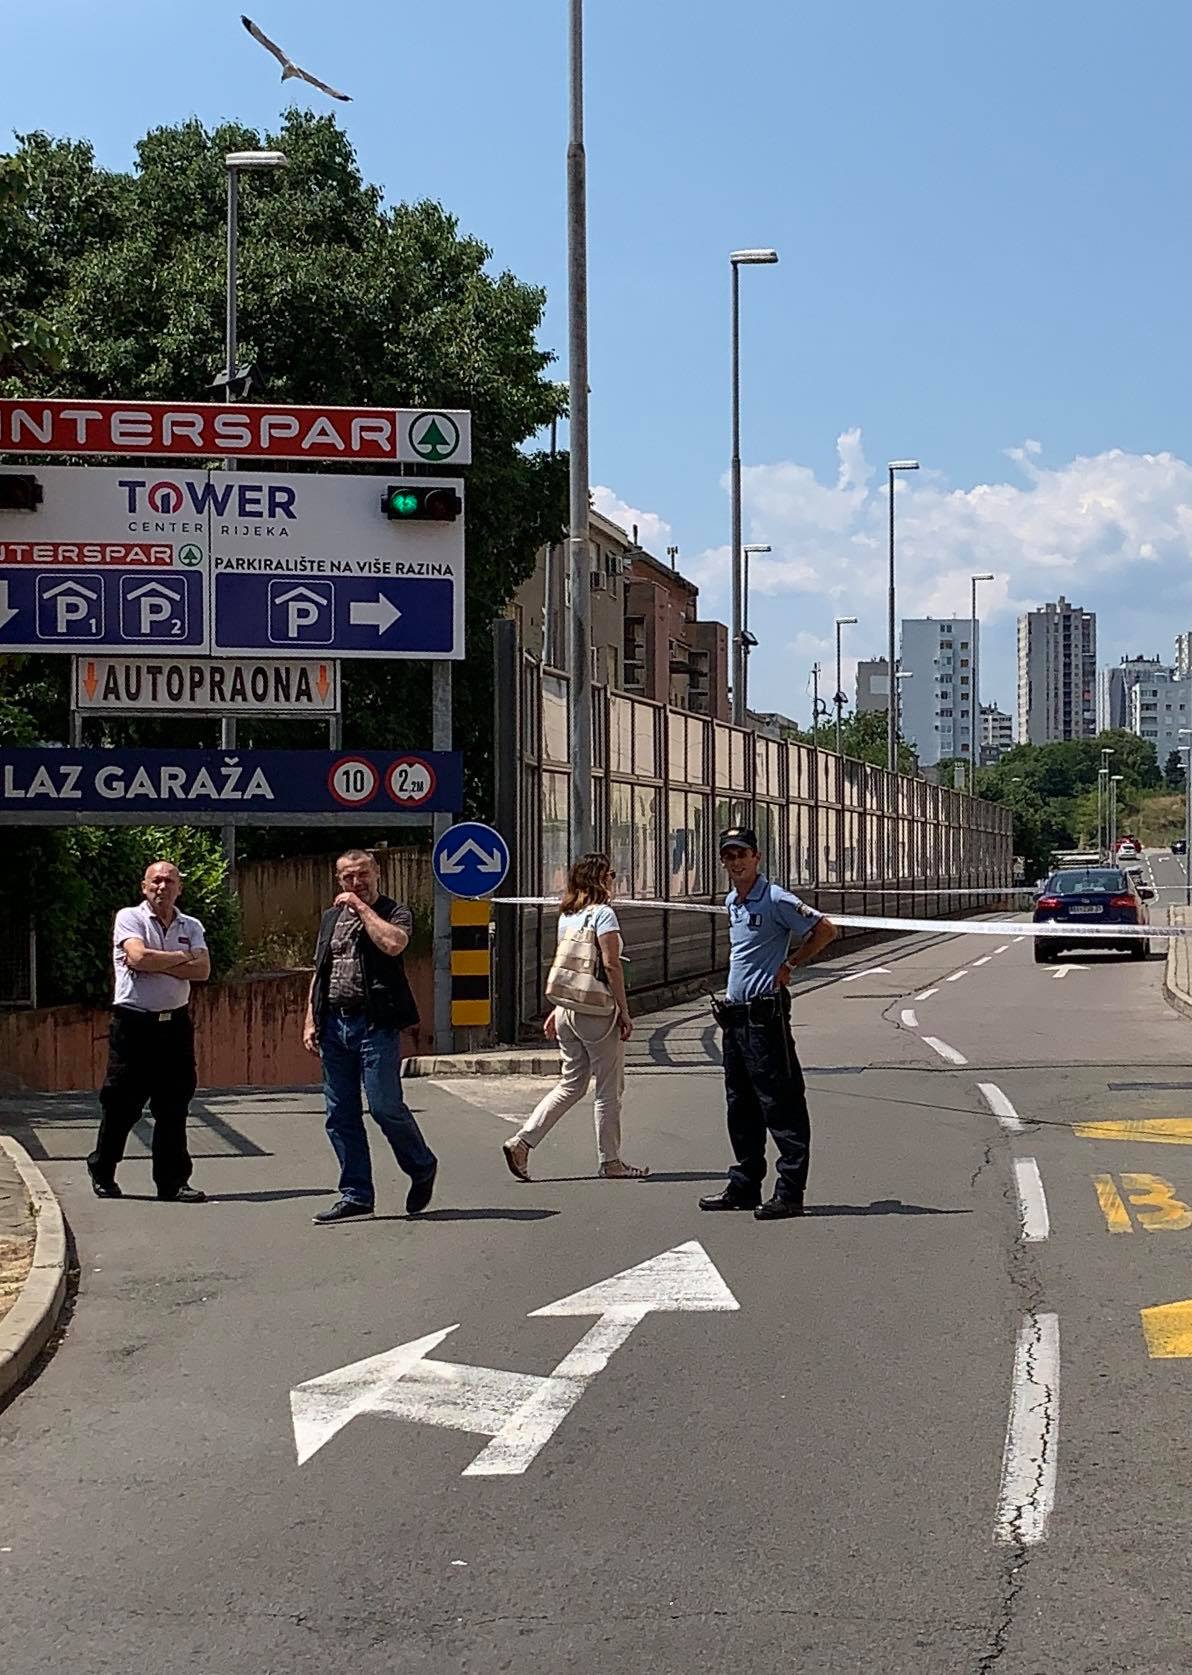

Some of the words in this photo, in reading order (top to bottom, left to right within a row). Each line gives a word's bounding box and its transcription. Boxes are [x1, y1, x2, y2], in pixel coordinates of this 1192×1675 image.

[0, 409, 393, 452] NTERSPAR
[118, 480, 297, 520] TOWER
[128, 521, 204, 533] CENTER
[221, 525, 289, 537] RIJEKA
[214, 556, 326, 573] PARKIRALIŠTE
[330, 559, 353, 573] NA
[356, 557, 391, 574] VIŠE
[395, 562, 454, 576] RAZINA
[102, 664, 314, 703] AUTOPRAONA
[4, 765, 82, 798] LAZ
[94, 756, 276, 800] GARAŽA
[342, 769, 365, 793] 10
